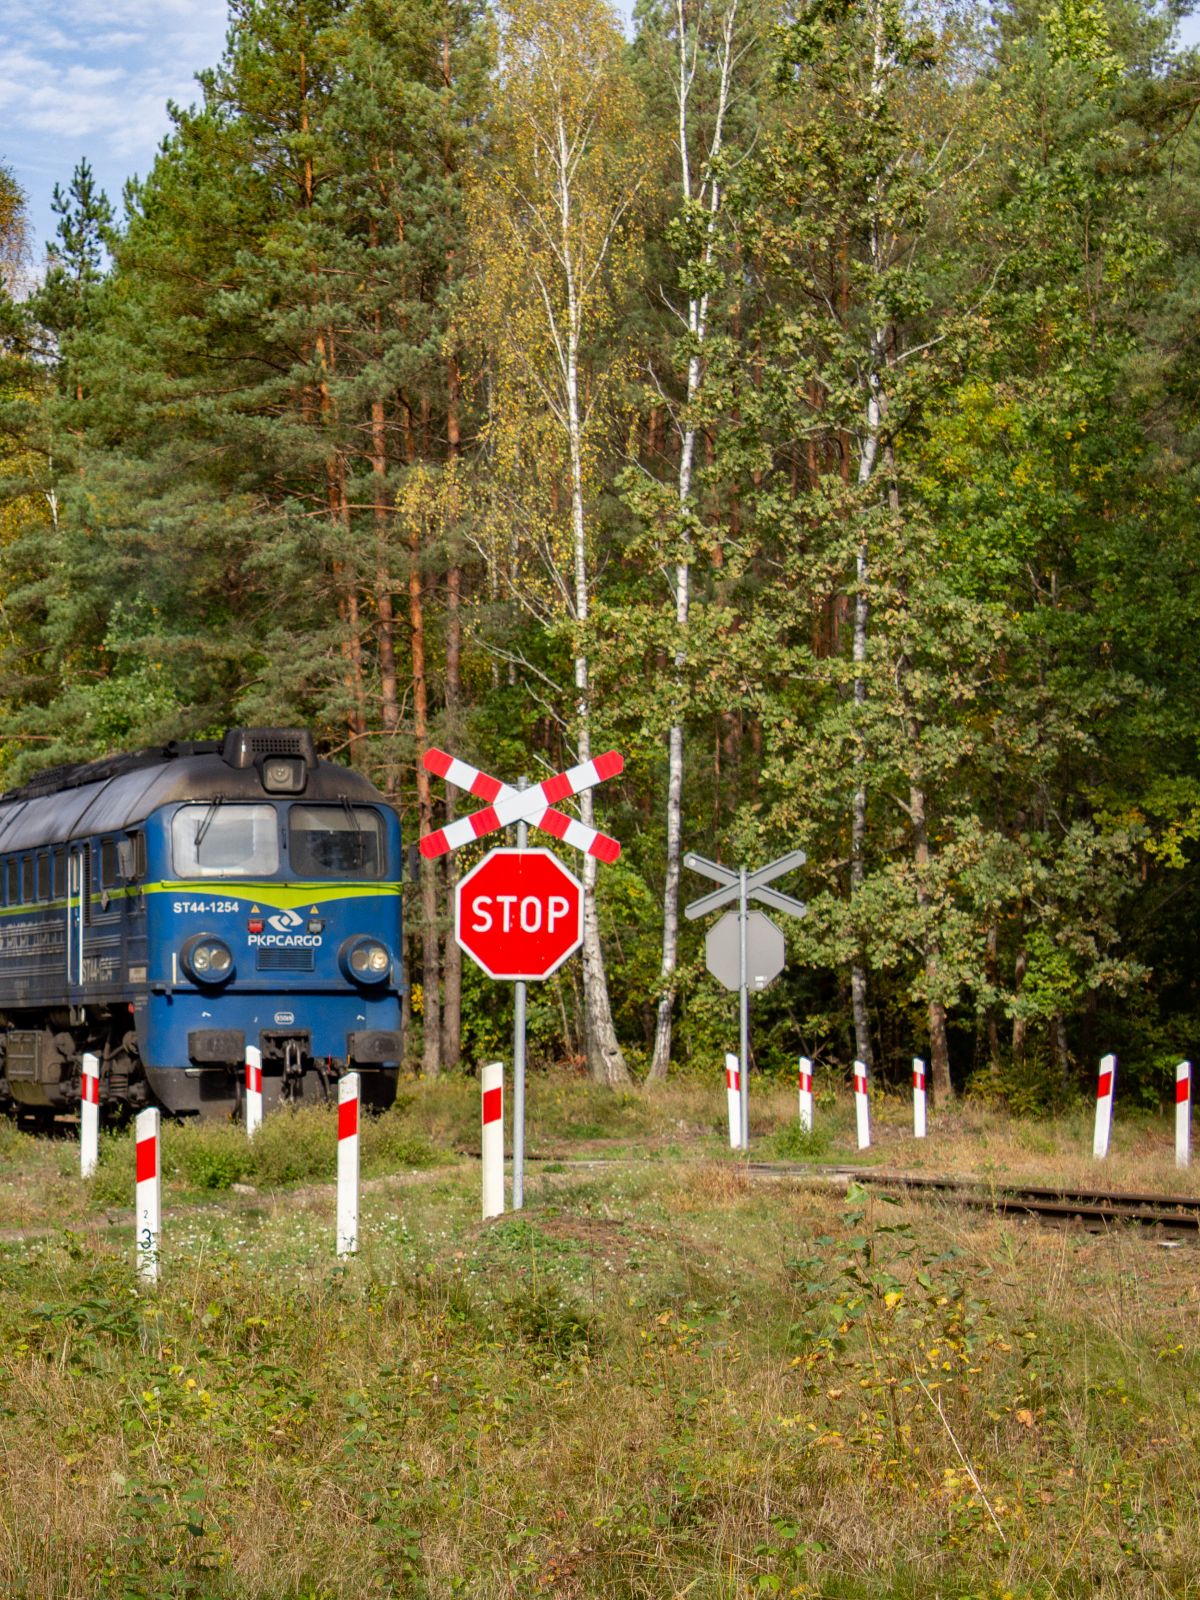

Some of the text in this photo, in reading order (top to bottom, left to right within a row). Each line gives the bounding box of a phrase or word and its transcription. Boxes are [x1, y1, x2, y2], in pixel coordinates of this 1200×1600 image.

[173, 902, 239, 913] ST44-1254
[472, 895, 569, 933] STOP
[248, 935, 322, 946] PKPCARGO
[141, 1228, 152, 1250] 3
